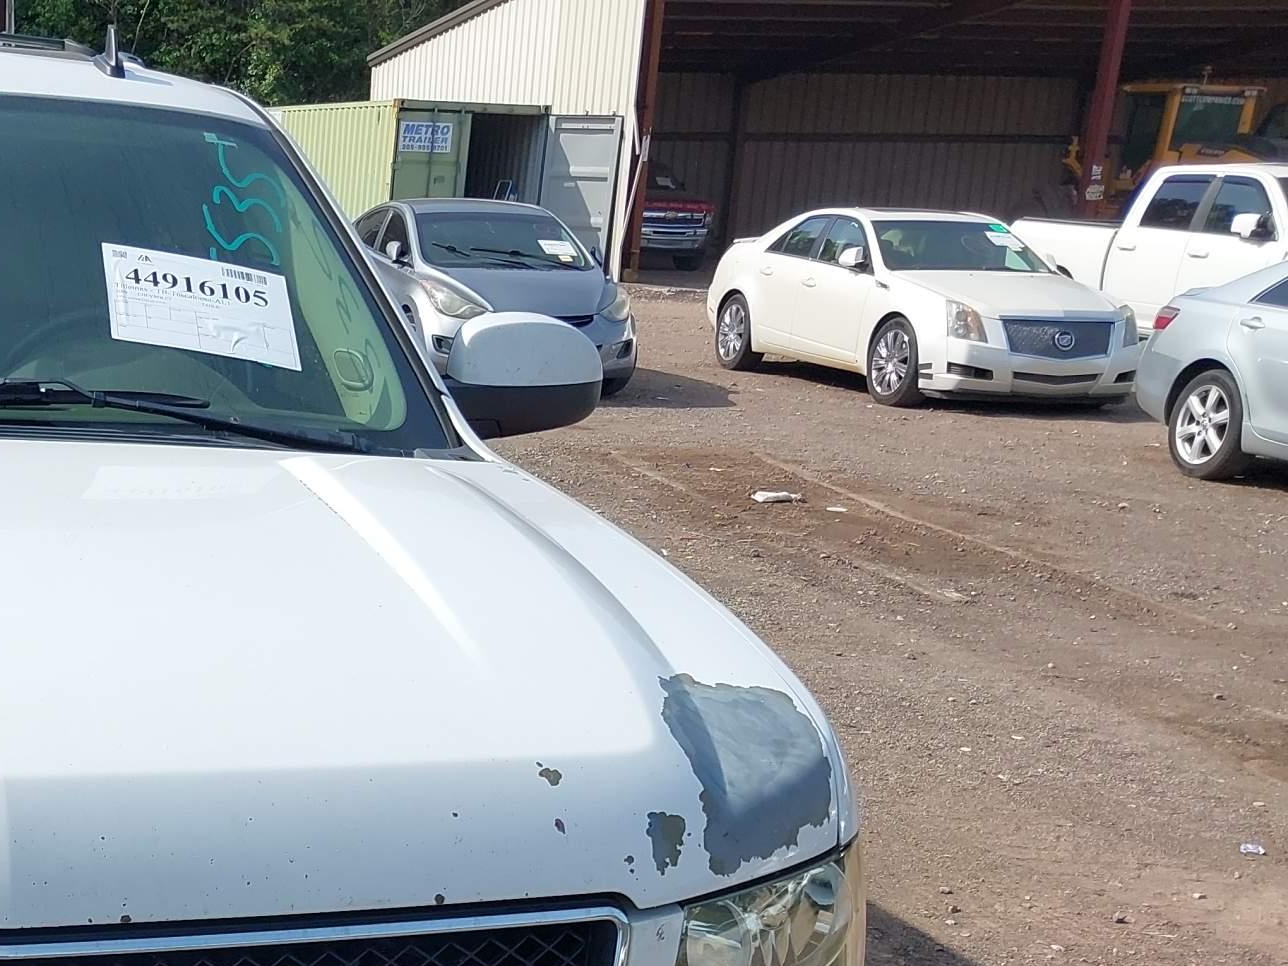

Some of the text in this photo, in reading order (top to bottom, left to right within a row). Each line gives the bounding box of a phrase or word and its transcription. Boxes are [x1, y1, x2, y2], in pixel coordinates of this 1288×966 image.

[402, 123, 451, 136] METRO
[402, 135, 449, 145] TRAILER
[125, 267, 269, 308] 44916105
